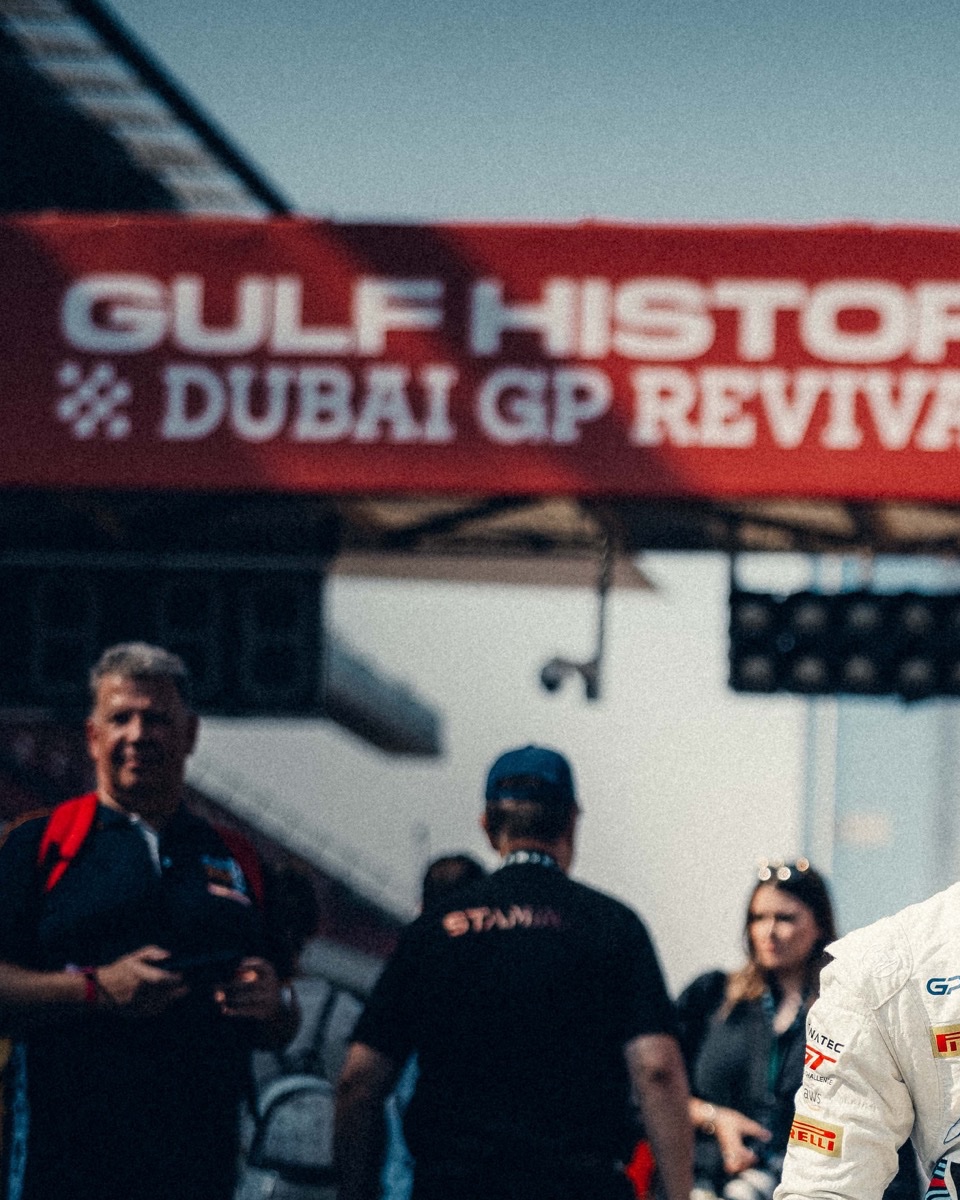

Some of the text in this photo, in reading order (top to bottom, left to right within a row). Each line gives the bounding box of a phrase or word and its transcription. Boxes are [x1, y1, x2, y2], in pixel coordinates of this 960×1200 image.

[60, 272, 445, 357] GULF
[161, 363, 458, 445] DUBAI
[476, 364, 613, 446] GP
[790, 1120, 836, 1151] RELLI
